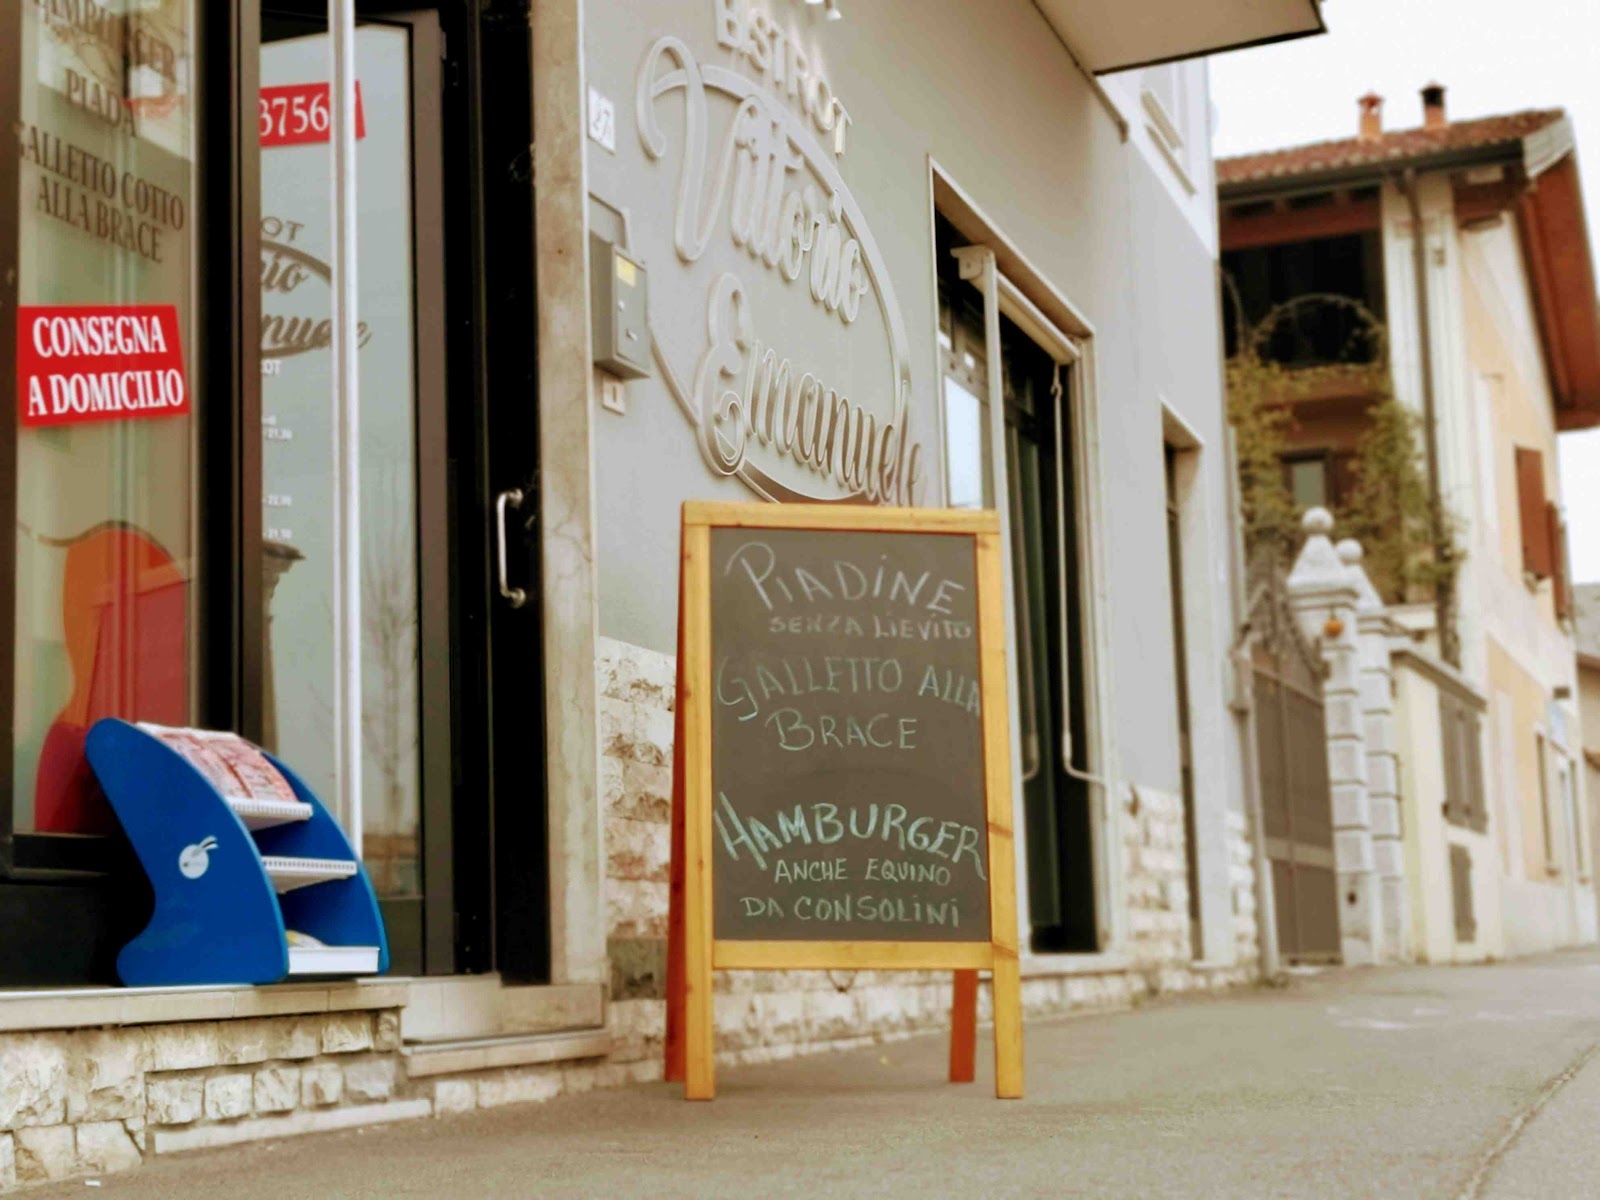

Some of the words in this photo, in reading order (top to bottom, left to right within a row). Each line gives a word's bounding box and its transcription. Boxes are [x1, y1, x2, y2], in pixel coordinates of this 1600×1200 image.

[64, 67, 137, 137] PIADA
[37, 176, 91, 232] ALLA
[96, 201, 163, 263] BRACE
[122, 171, 185, 232] COTTO
[32, 315, 168, 357] CONSEGNA
[28, 376, 48, 416] A
[49, 369, 184, 415] DOMICILIO
[769, 614, 864, 637] SENZA
[716, 655, 904, 721] GALLETTO
[917, 665, 981, 718] ALLA
[764, 707, 920, 751] BRACE
[714, 791, 987, 881] HAMBURGER
[774, 858, 848, 884] ANCHE
[864, 857, 951, 886] EQUINO
[739, 896, 785, 918] DA
